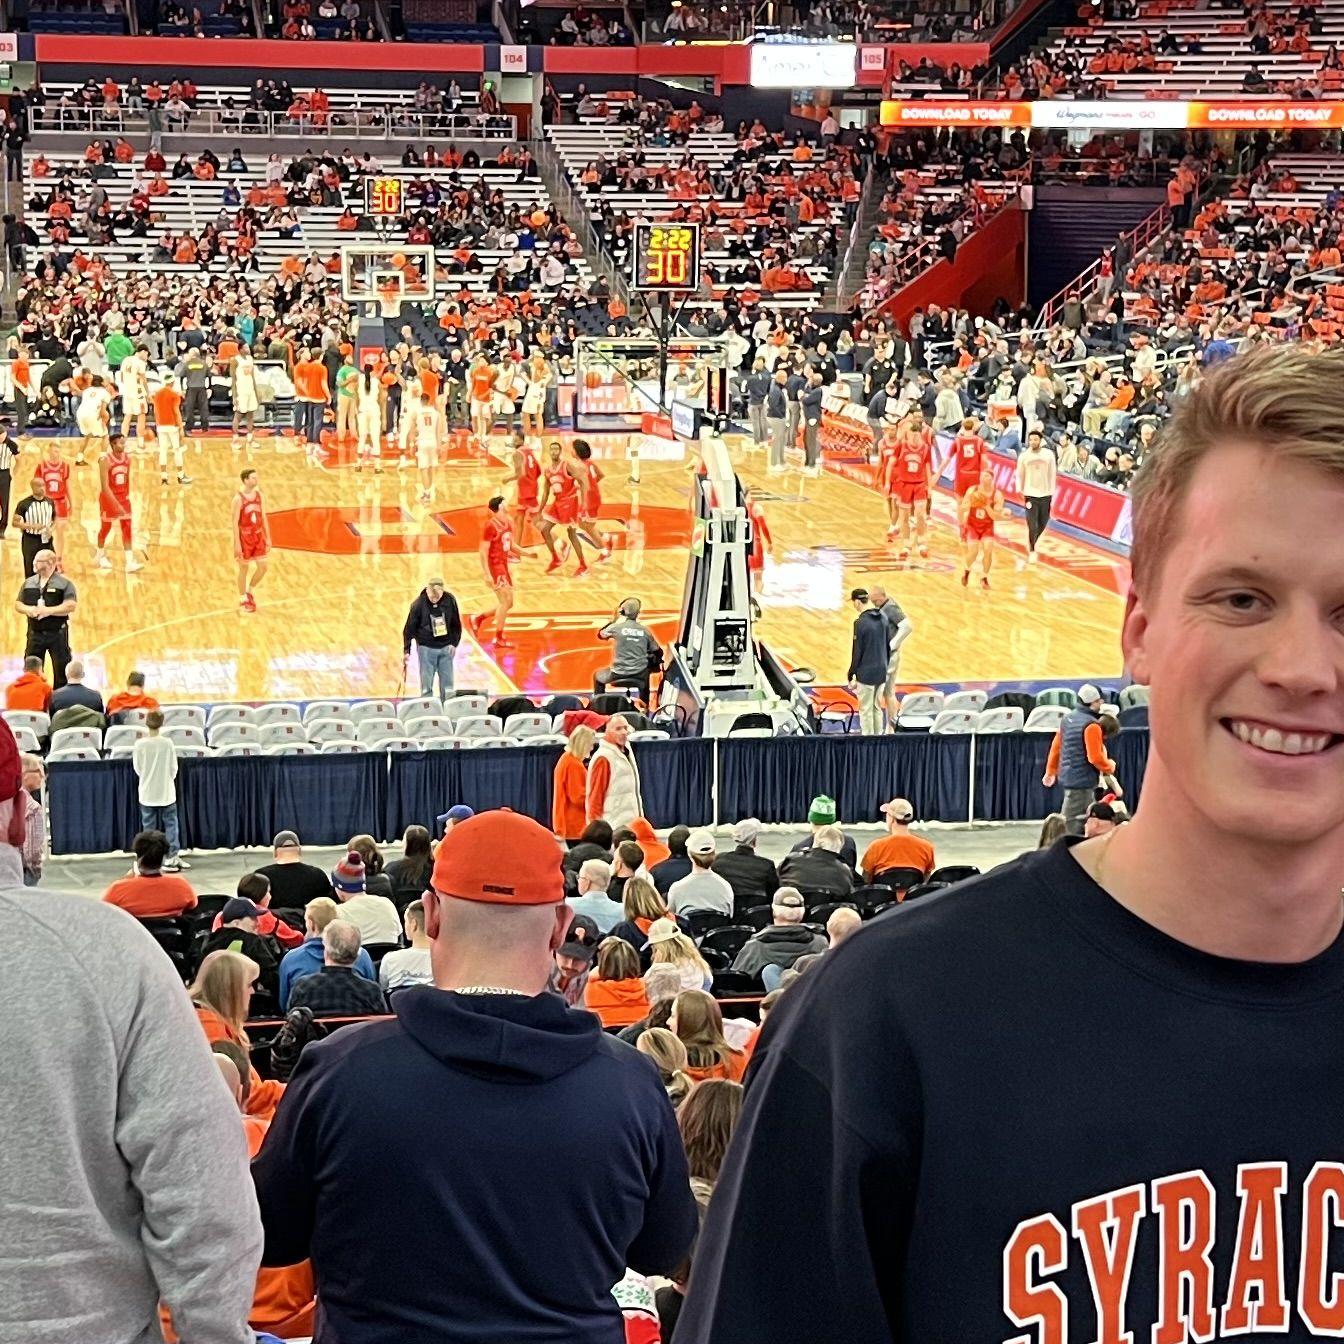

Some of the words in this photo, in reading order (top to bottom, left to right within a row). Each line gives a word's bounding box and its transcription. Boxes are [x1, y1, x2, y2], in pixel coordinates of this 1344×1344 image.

[504, 53, 524, 65] 104
[900, 107, 971, 121] DOWNLOAD
[972, 107, 1012, 121] TODAY
[1207, 107, 1286, 122] DOWNLOAD
[1287, 107, 1332, 121] TODAY
[374, 181, 399, 193] 2:22
[372, 193, 396, 213] 30
[649, 228, 693, 251] 2:22
[646, 250, 686, 283] 30
